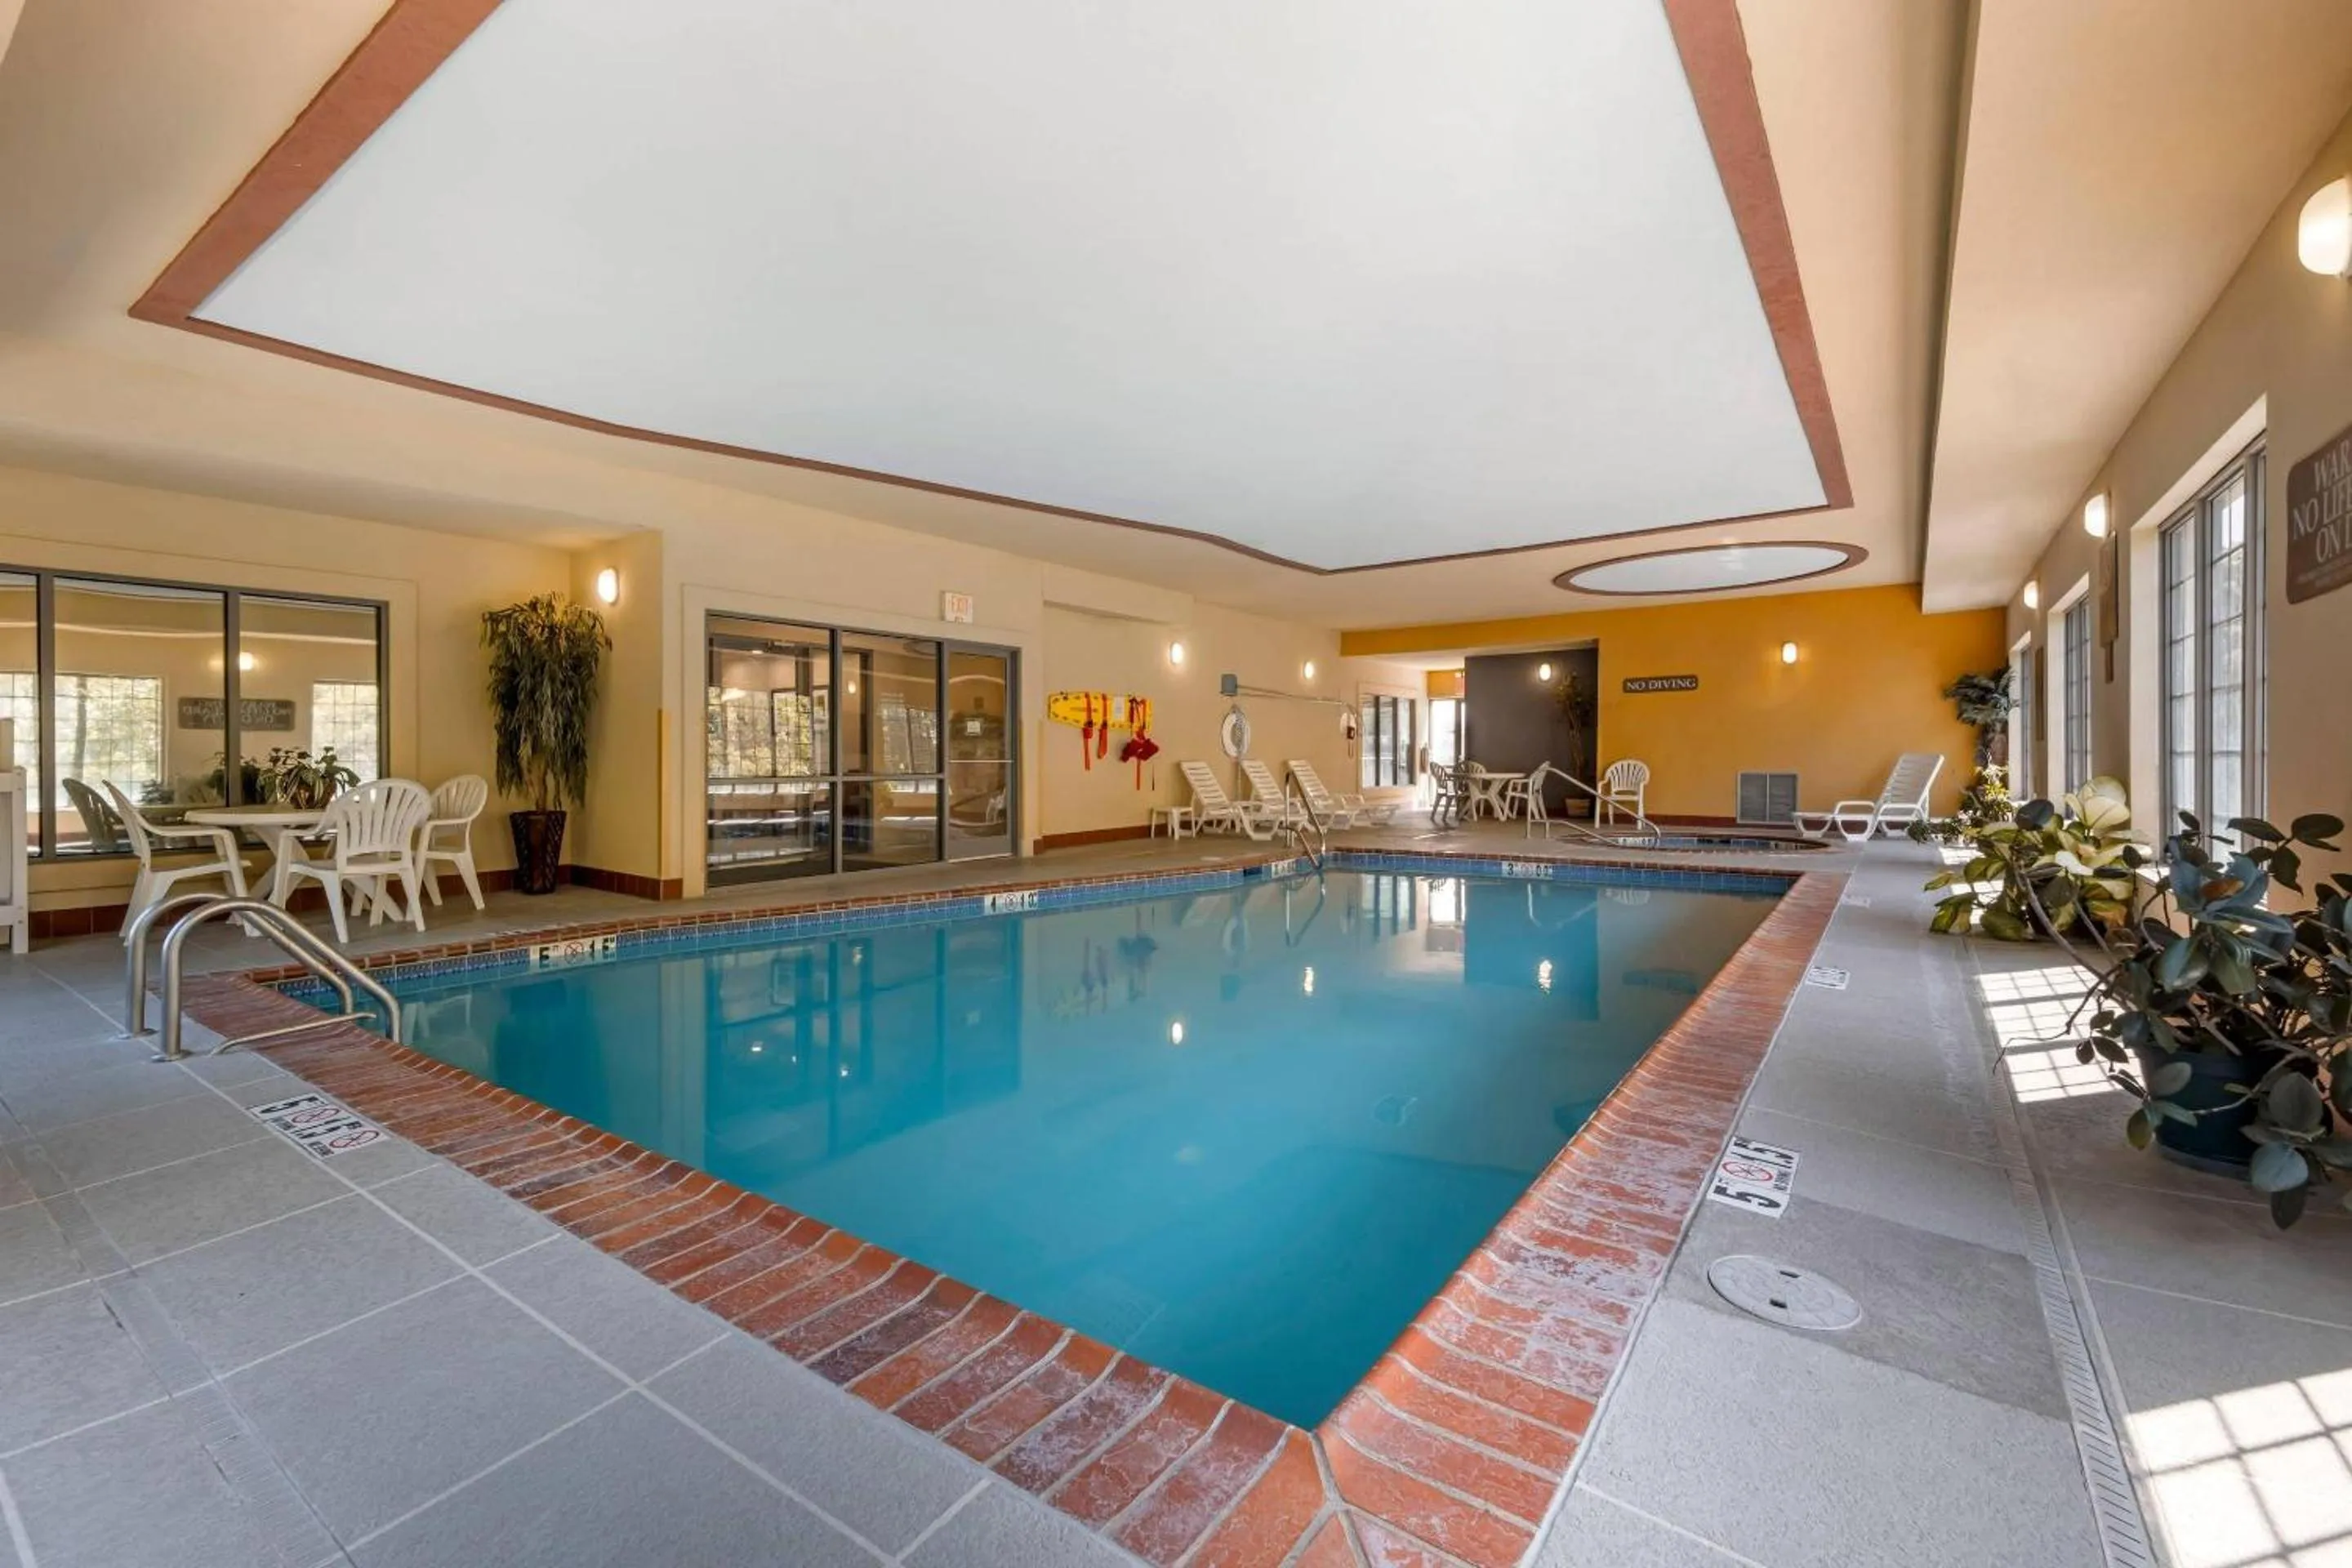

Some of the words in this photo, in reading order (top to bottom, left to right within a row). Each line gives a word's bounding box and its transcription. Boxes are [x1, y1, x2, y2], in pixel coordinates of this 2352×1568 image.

[2292, 497, 2319, 540] NO
[2316, 519, 2341, 563] ON
[1627, 680, 1646, 691] NO
[1649, 678, 1696, 689] DIVING
